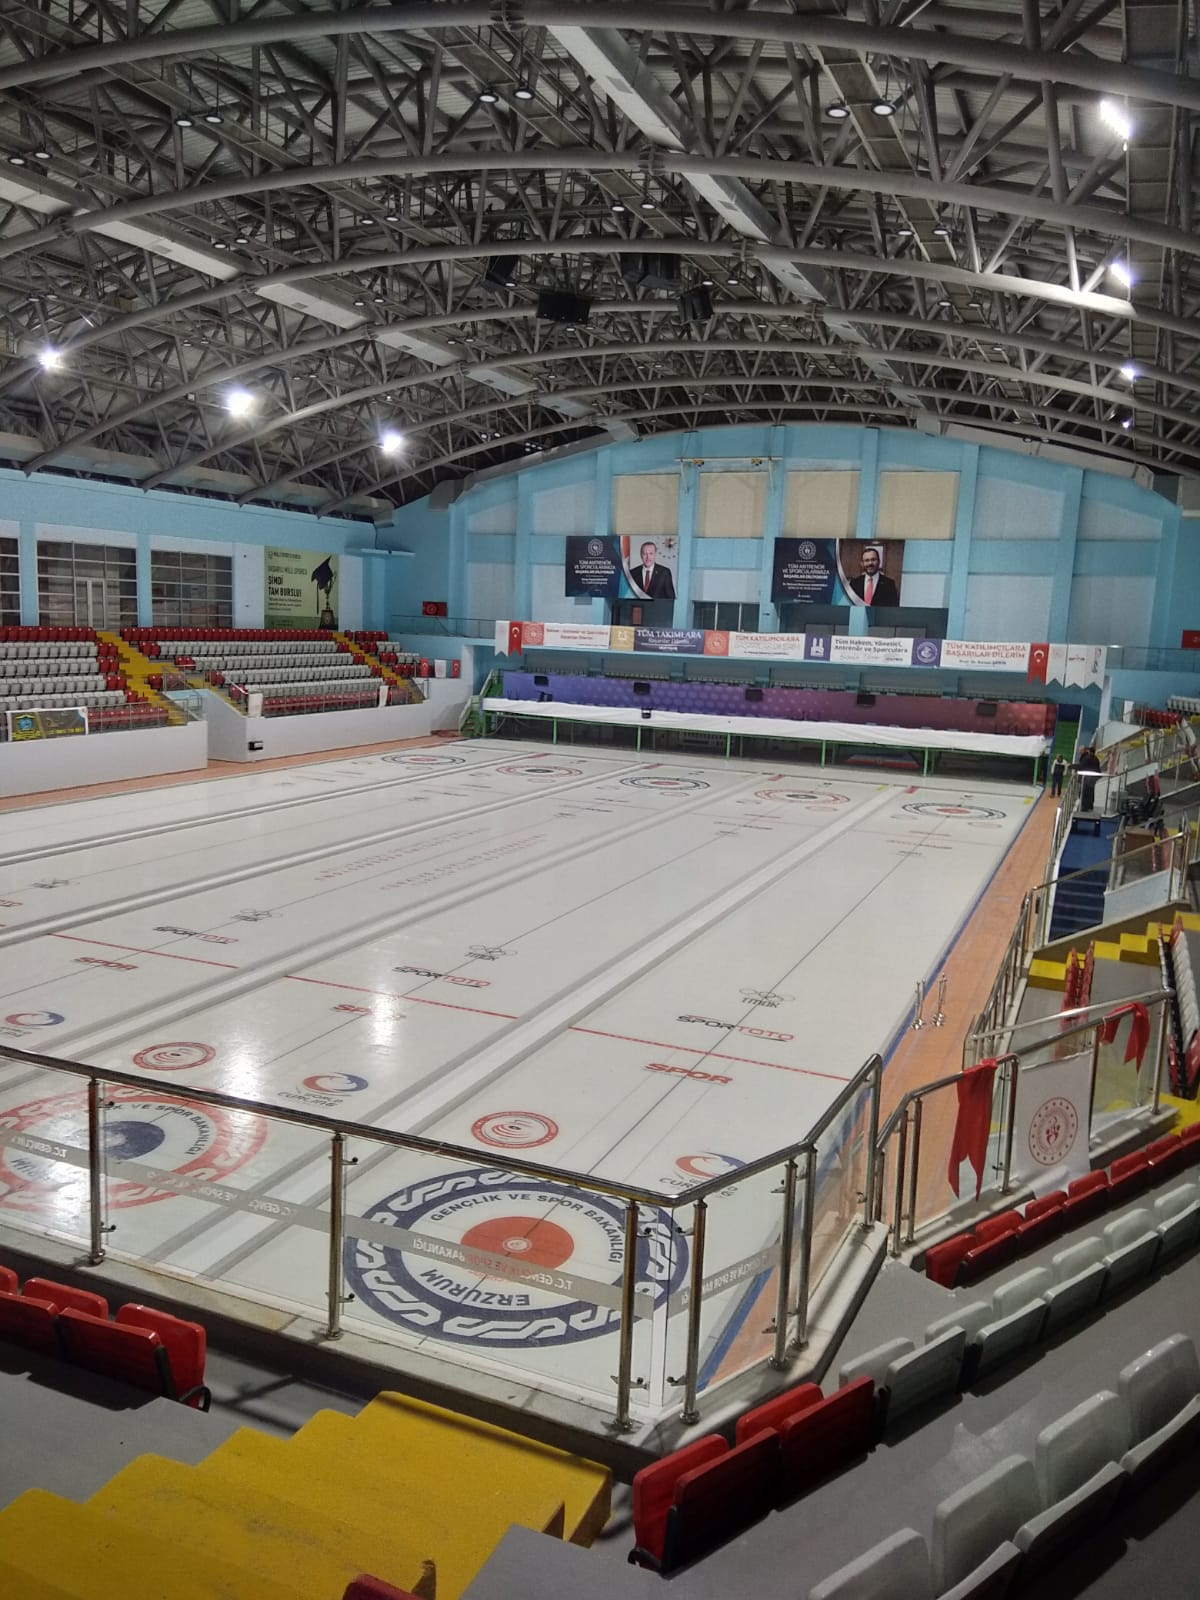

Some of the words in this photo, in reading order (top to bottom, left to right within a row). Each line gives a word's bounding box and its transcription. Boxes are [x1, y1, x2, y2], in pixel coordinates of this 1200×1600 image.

[268, 586, 279, 596] TAM
[637, 628, 654, 638] TÜM
[655, 630, 701, 639] TAKIMLARA
[644, 1062, 733, 1084] SPOR
[157, 1104, 193, 1118] SPOR
[430, 1192, 501, 1222] GENÇLİK
[508, 1192, 532, 1201] VE
[536, 1194, 584, 1212] SPOR
[420, 1268, 531, 1308] ERZURUM
